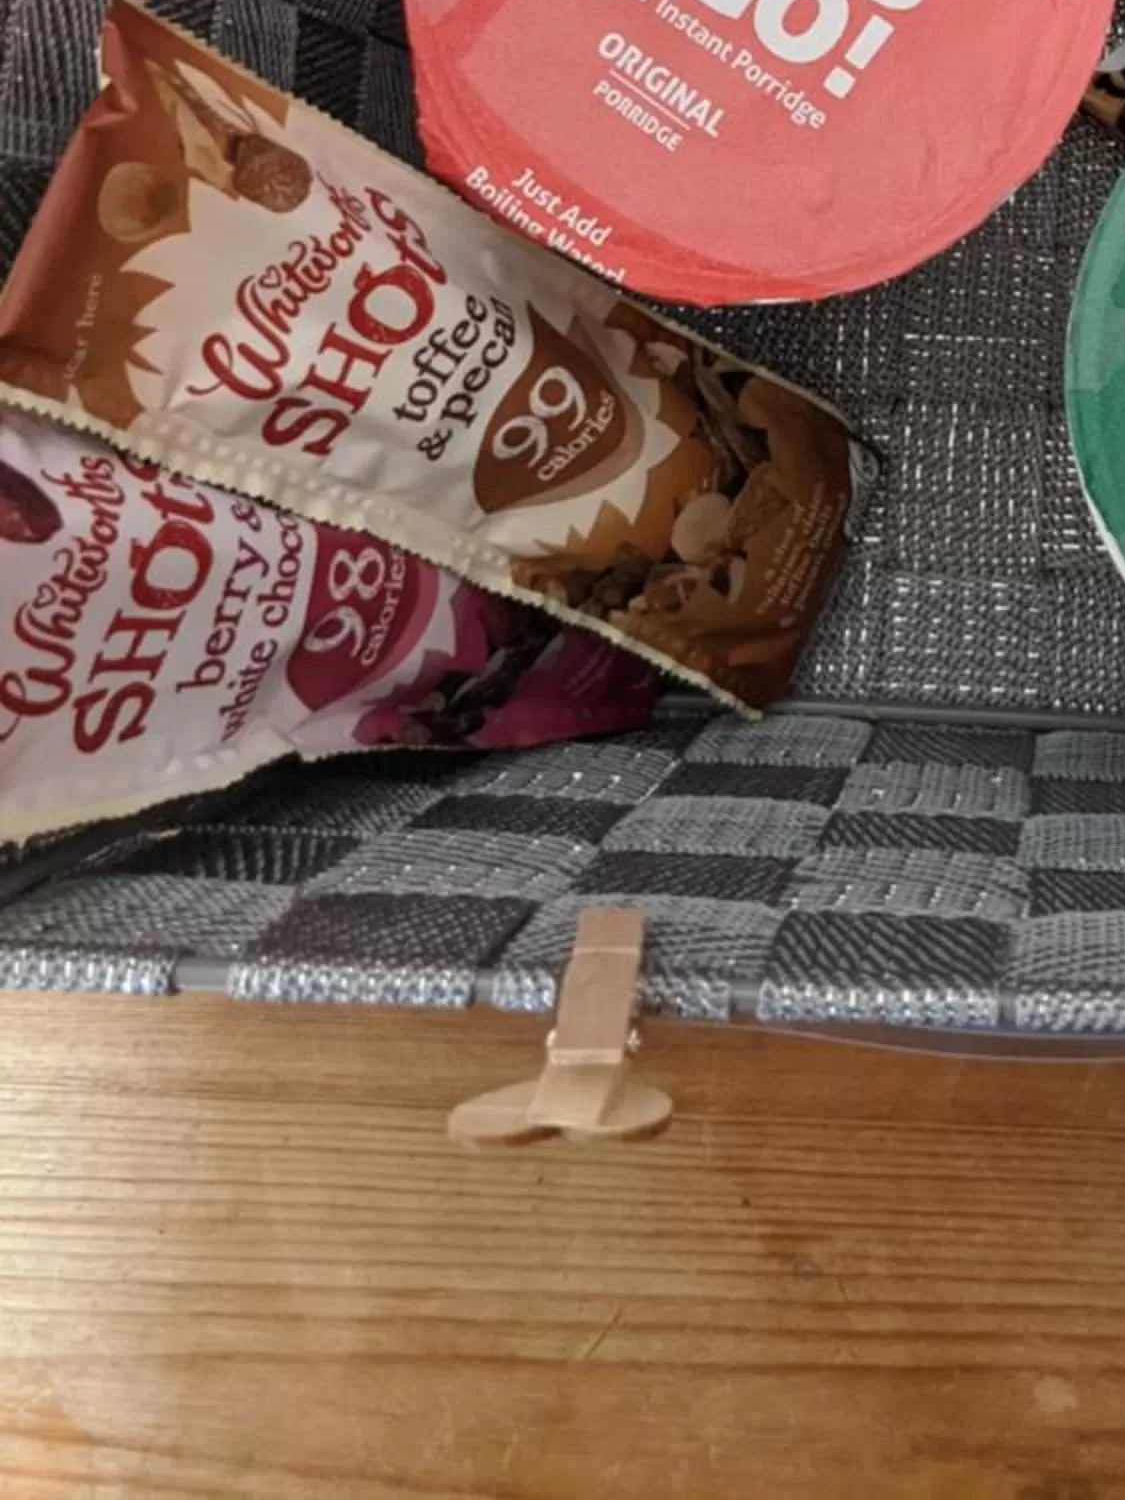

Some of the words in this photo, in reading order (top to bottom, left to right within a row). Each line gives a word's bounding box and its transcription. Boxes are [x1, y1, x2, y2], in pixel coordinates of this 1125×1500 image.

[592, 80, 685, 152] PORRIDGE
[597, 32, 726, 139] ORIGINAL
[731, 49, 828, 130] Porridge
[511, 168, 563, 214] Just
[557, 205, 613, 248] Add
[393, 292, 489, 425] toffee
[416, 426, 454, 461] &
[441, 295, 518, 428] pecan
[491, 364, 588, 468] 99
[535, 389, 617, 481] calories
[176, 537, 270, 694] berry
[231, 501, 264, 533] &
[303, 547, 386, 659] 98
[218, 638, 279, 743] white
